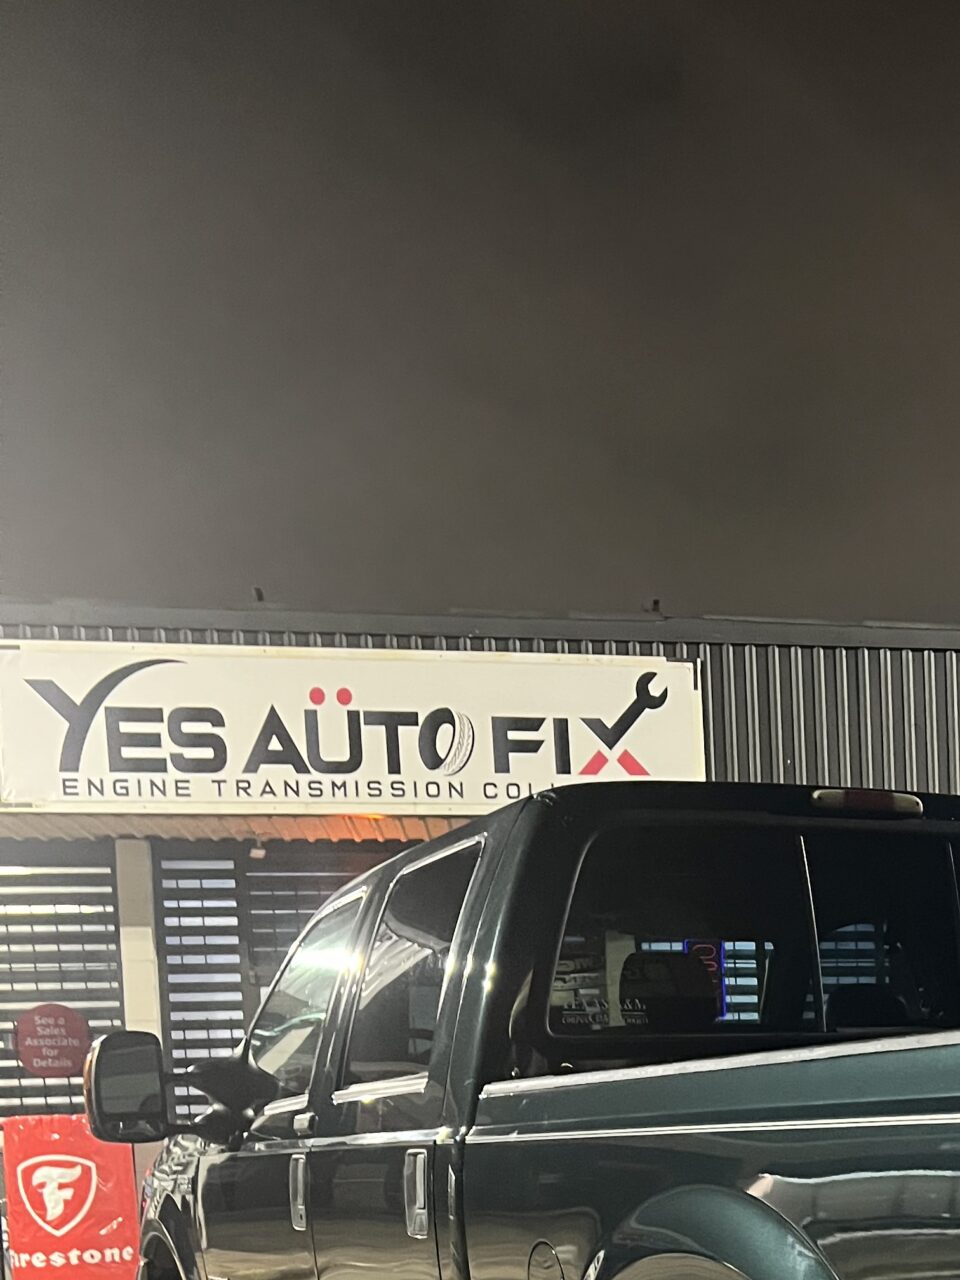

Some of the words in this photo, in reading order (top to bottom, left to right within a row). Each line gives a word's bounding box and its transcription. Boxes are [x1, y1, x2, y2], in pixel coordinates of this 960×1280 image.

[24, 659, 227, 774] YES
[492, 671, 669, 776] FIX
[62, 778, 191, 797] ENGINE
[211, 779, 464, 799] TRANSMISSION
[33, 1015, 54, 1025] See
[57, 1017, 65, 1025] a
[36, 1026, 66, 1036] Sales
[25, 1036, 80, 1047] Associate
[41, 1047, 59, 1057] for
[32, 1058, 73, 1068] Details
